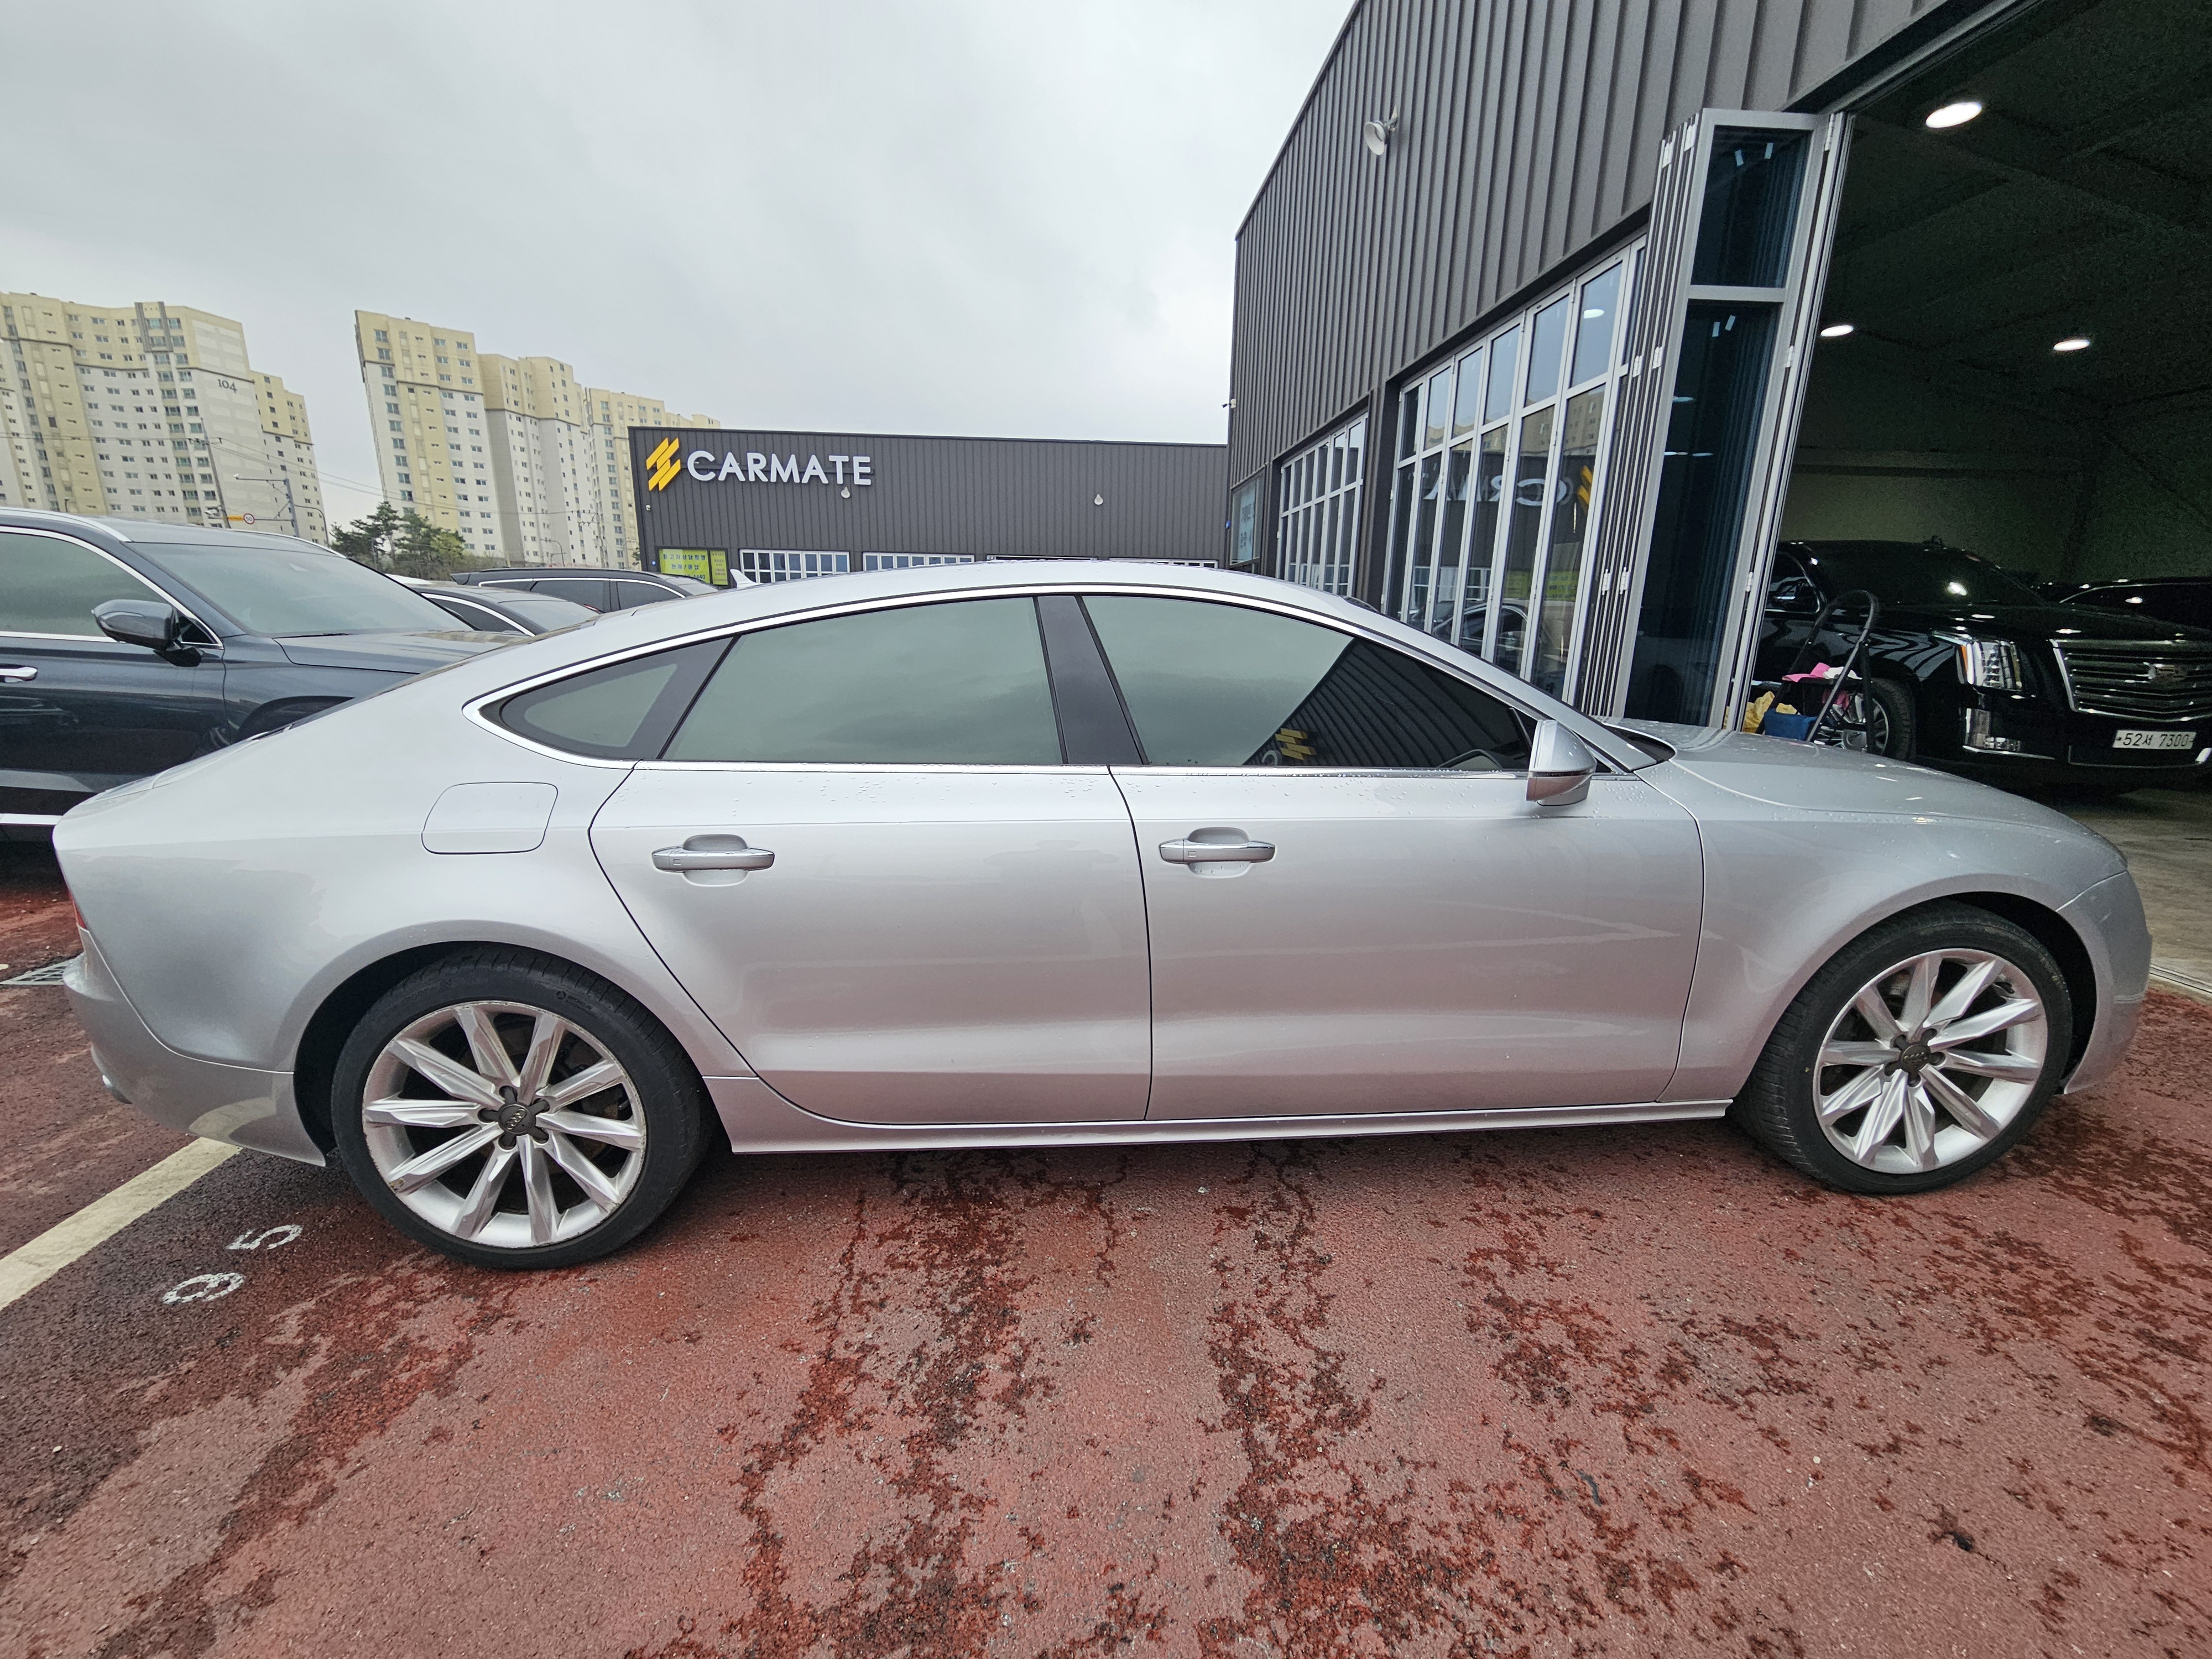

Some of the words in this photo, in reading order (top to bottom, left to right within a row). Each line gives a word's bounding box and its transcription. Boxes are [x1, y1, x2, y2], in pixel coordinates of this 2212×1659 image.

[217, 379, 237, 393] 104
[687, 450, 872, 486] CARMATE
[2123, 733, 2153, 746] 52서
[2158, 734, 2189, 747] 7300
